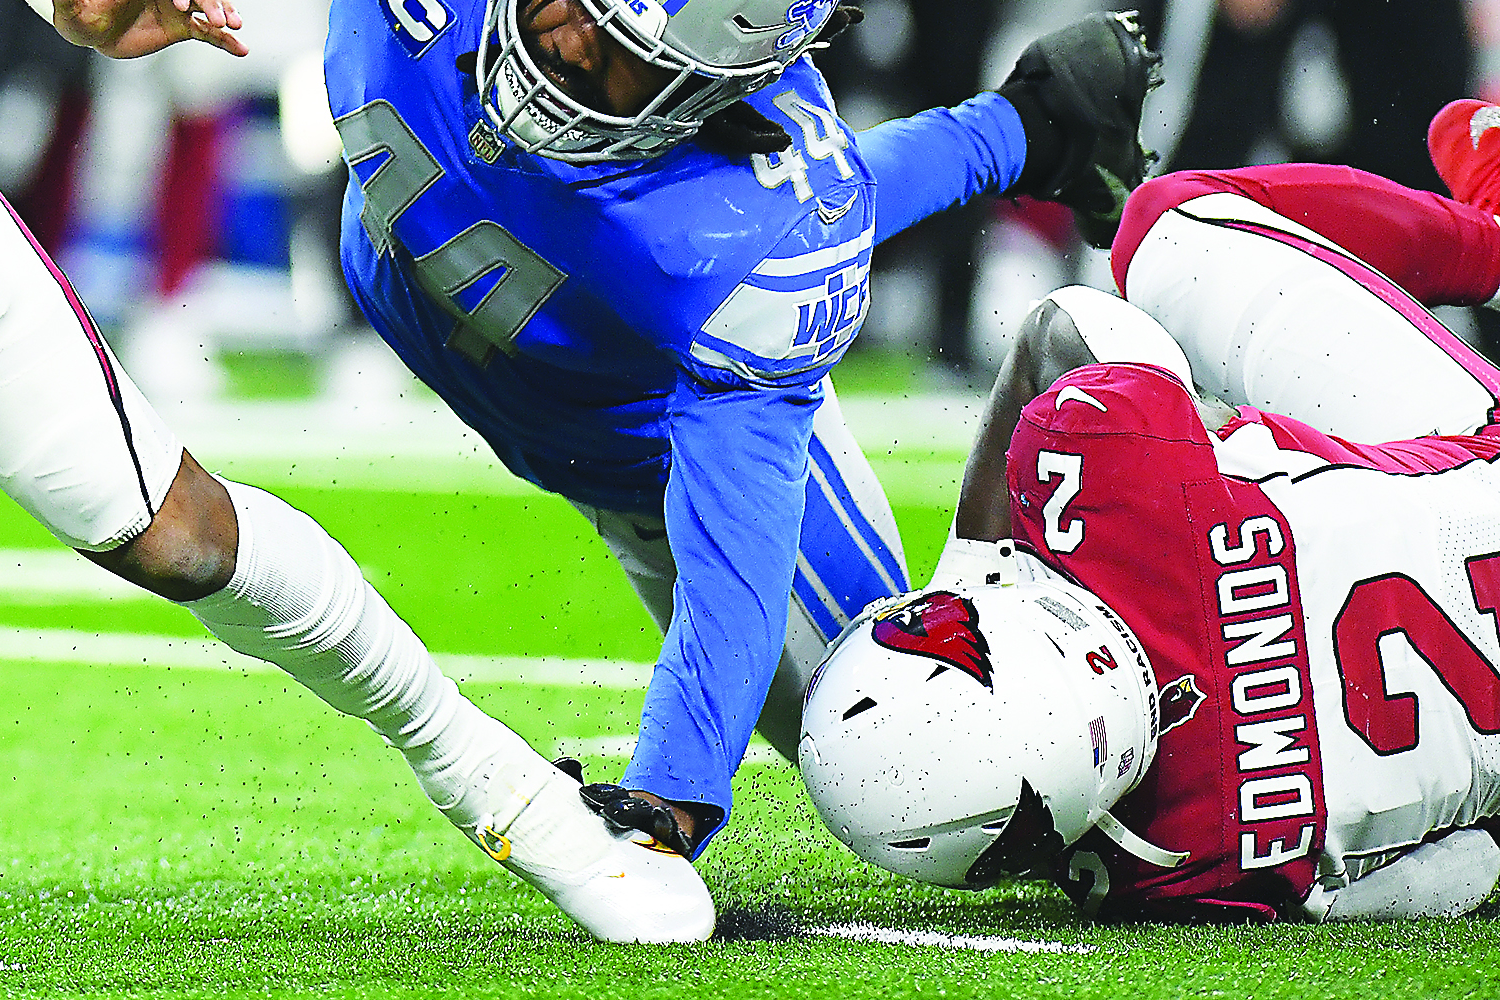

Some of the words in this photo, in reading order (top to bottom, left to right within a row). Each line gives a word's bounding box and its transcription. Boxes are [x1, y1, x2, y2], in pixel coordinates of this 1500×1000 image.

[1036, 448, 1086, 555] 2
[1085, 644, 1118, 676] 2
[1094, 605, 1151, 688] RACISM
[1209, 515, 1316, 871] EDMONDS
